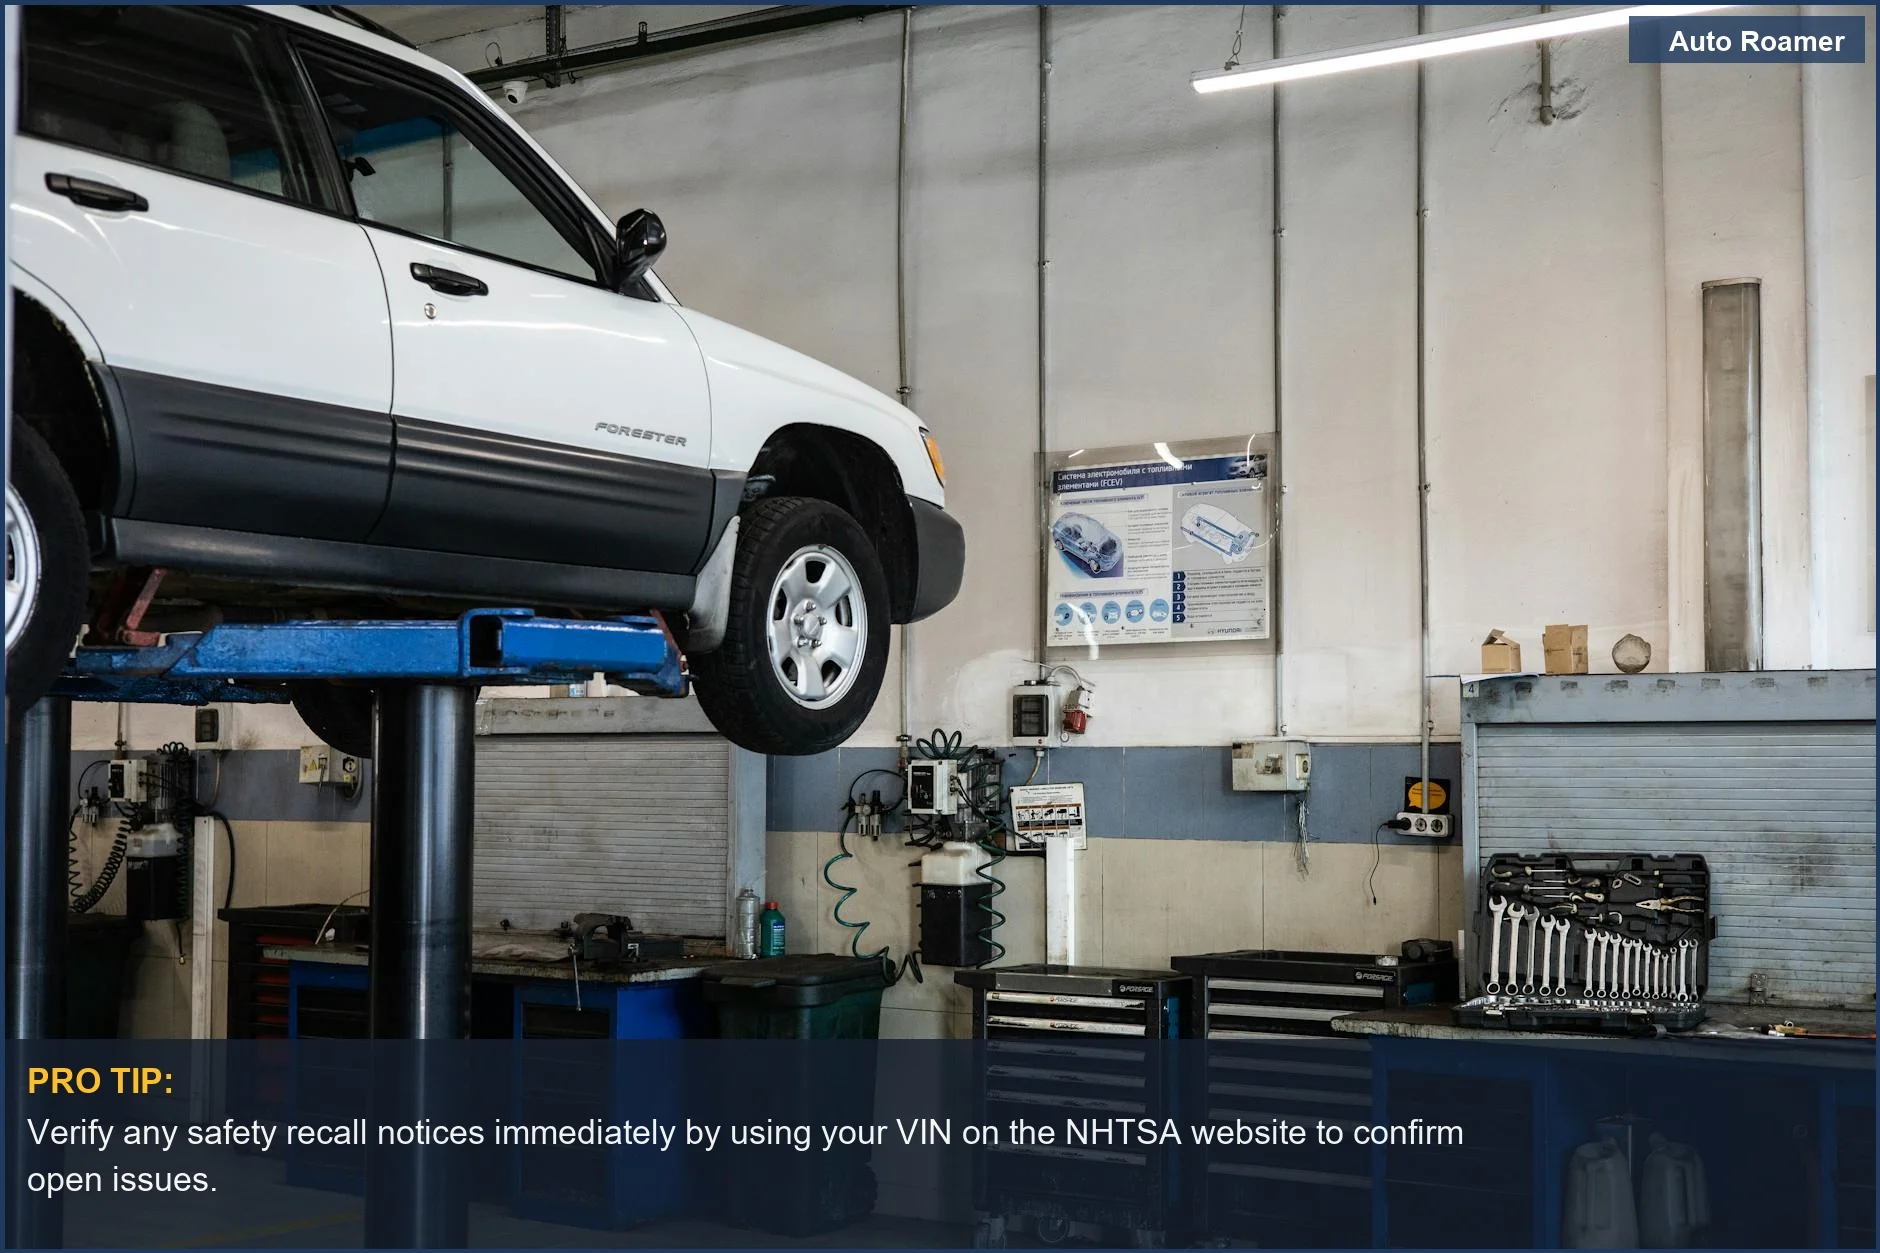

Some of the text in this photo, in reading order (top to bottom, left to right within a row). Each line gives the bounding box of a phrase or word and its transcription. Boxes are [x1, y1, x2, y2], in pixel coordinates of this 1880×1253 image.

[594, 422, 688, 447] FORESTER
[1057, 472, 1086, 481] Система
[1087, 467, 1141, 479] электромобиля
[1147, 463, 1193, 473] топливми
[1057, 478, 1123, 491] элементами (FCEV)
[1362, 973, 1394, 982] FORSAGE
[1125, 985, 1154, 993] FORSAGE
